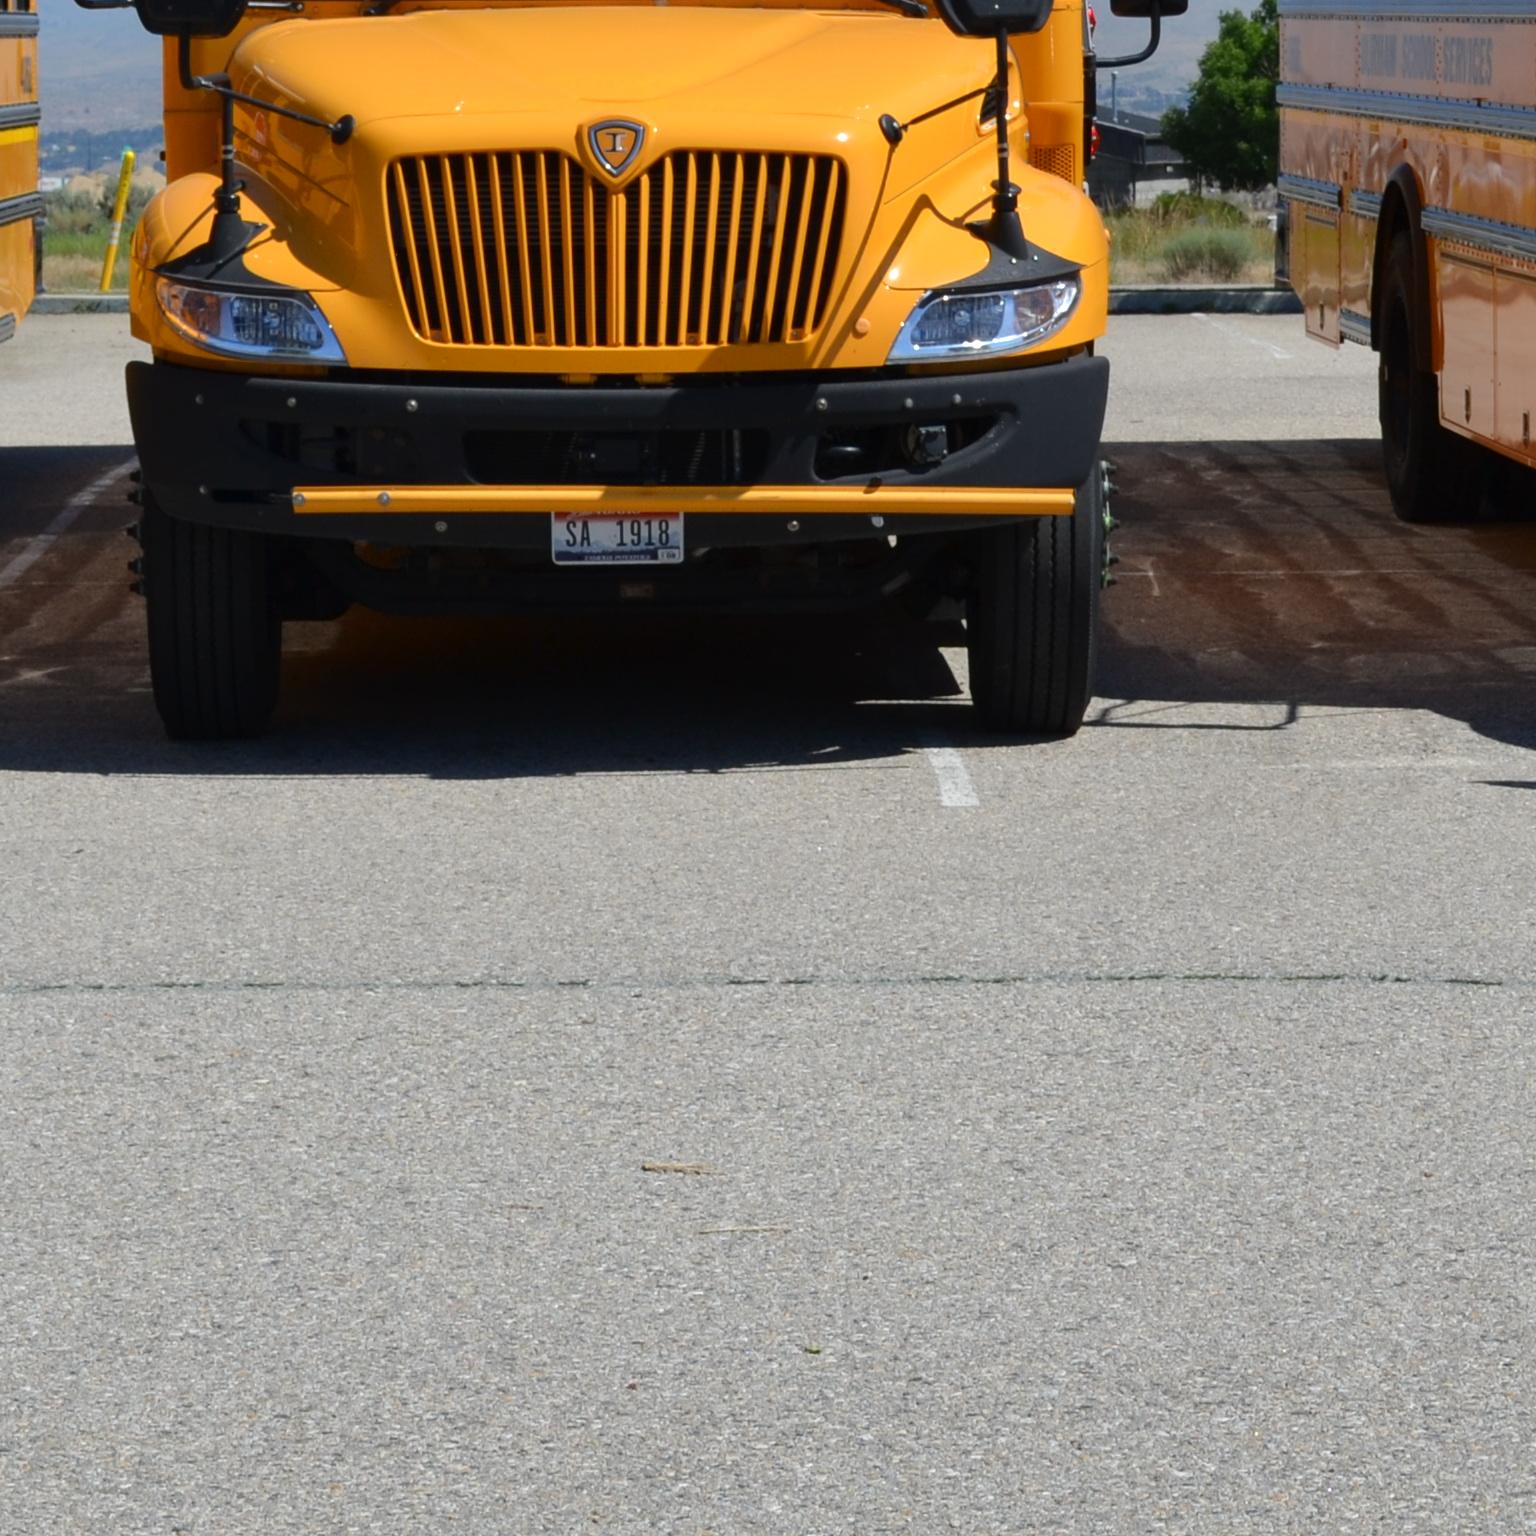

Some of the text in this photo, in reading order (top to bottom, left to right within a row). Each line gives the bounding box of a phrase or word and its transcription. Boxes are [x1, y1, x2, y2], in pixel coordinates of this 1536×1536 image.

[1444, 36, 1492, 86] SERVICES
[566, 519, 670, 547] SA 1918
